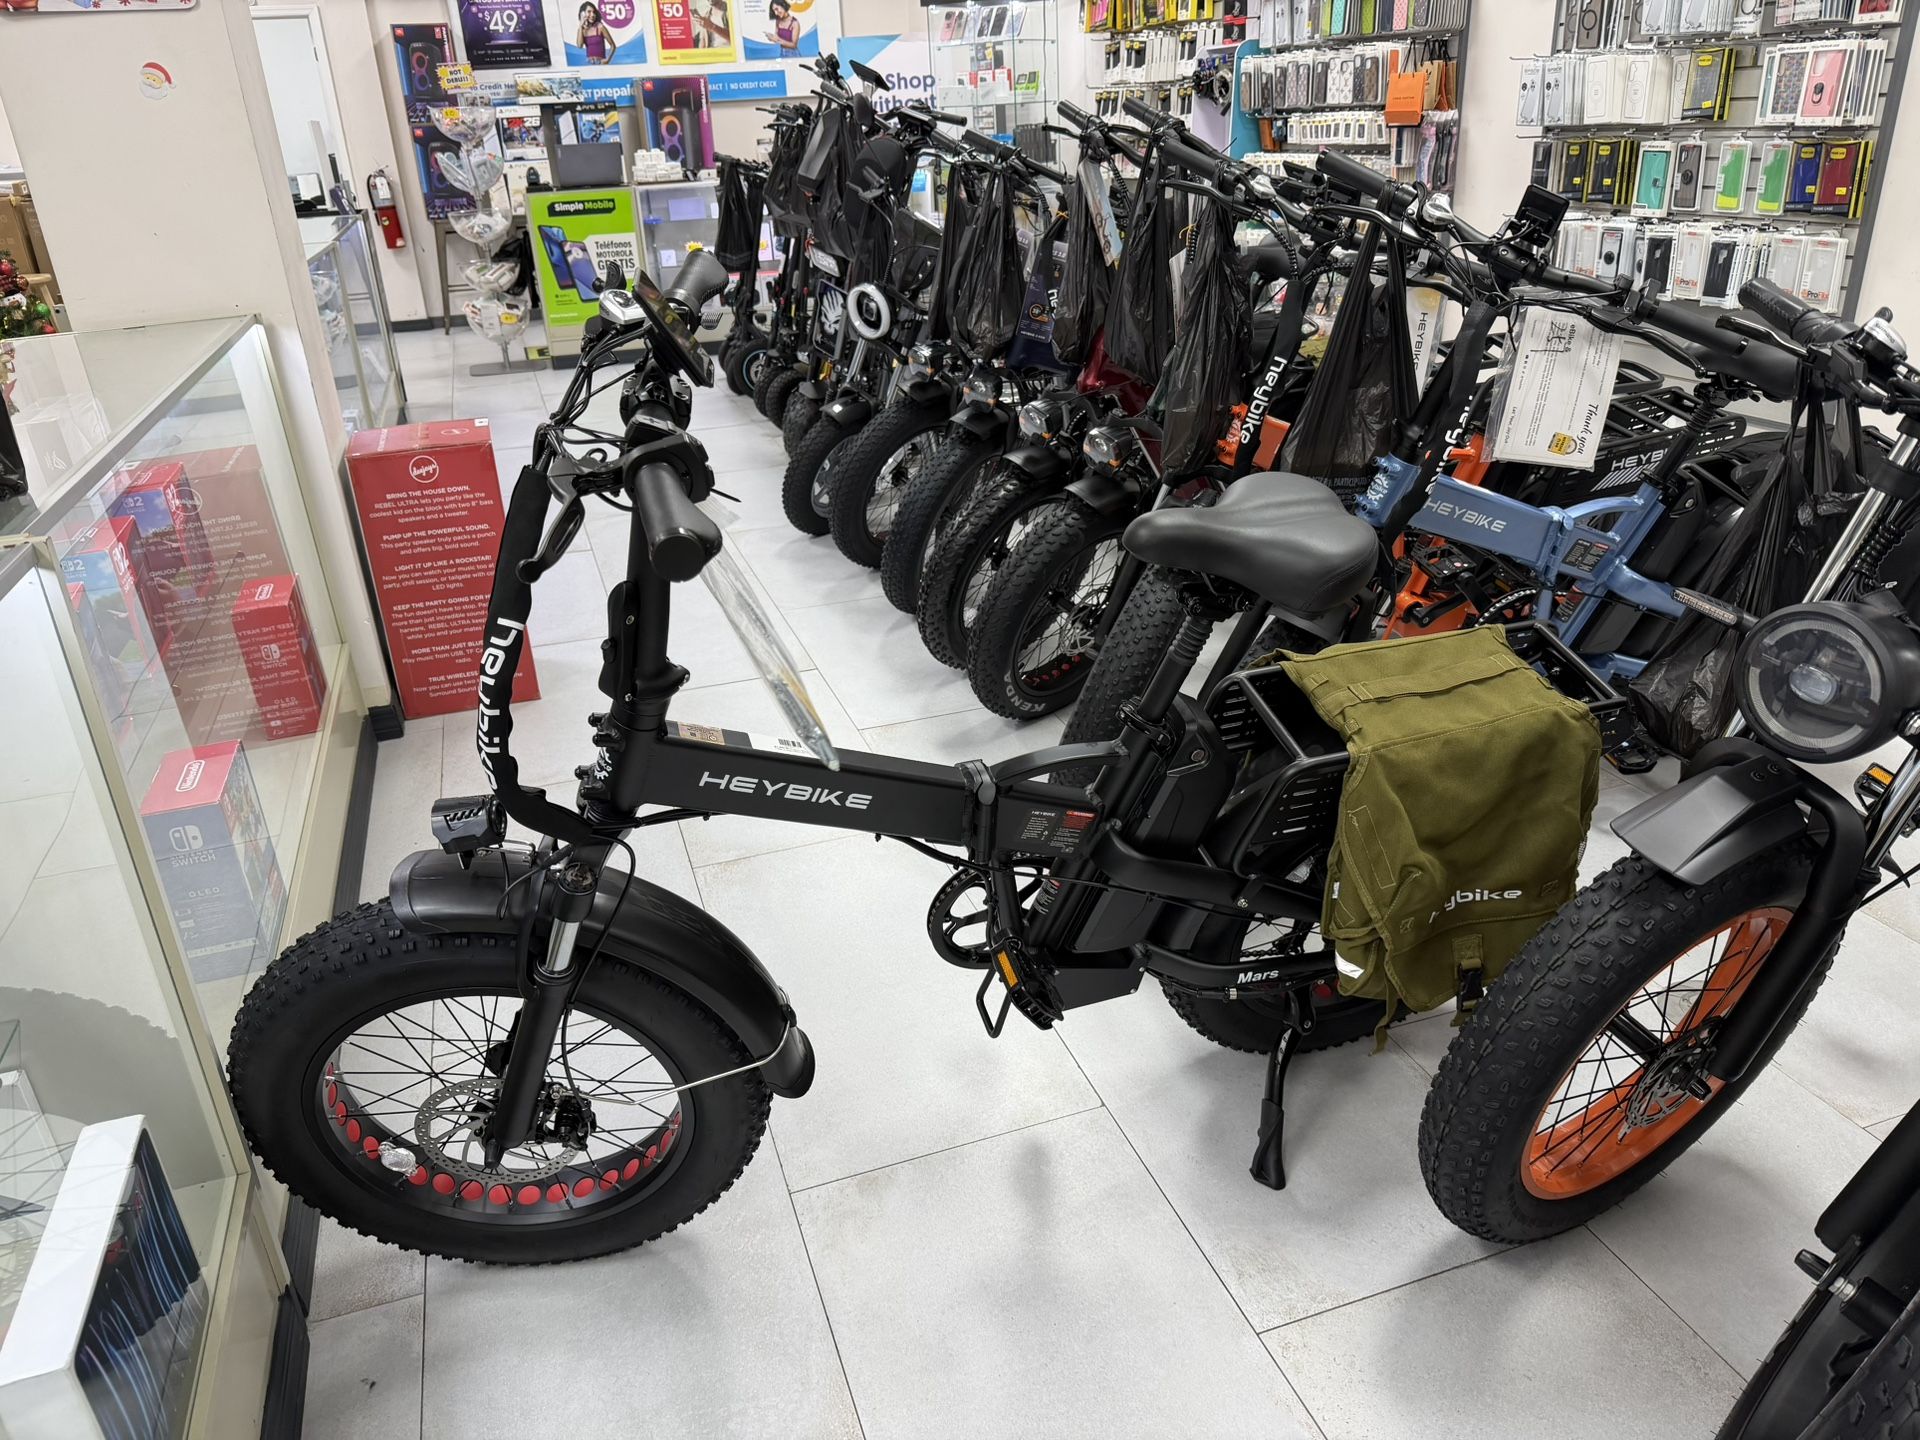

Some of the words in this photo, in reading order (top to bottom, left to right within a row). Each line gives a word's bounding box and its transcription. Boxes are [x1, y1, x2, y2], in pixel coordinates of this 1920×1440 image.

[601, 4, 625, 20] $50
[484, 9, 518, 33] $49
[480, 82, 503, 91] Credit
[739, 82, 758, 90] CREDIT
[759, 80, 777, 88] CHECK
[886, 72, 936, 92] Shop
[554, 202, 584, 212] Simple
[585, 200, 614, 210] Mobile
[594, 240, 633, 250] Teléfonos
[596, 249, 634, 259] MOTOROLA
[1565, 324, 1576, 346] eBike
[1241, 356, 1287, 445] heybike
[1579, 403, 1599, 437] Thank
[1576, 434, 1590, 455] you
[386, 491, 408, 499] BRING
[423, 487, 446, 496] HOUSE
[446, 485, 471, 493] DOWN.
[374, 501, 396, 509] REBEL
[445, 495, 462, 503] party
[425, 504, 442, 512] block
[1424, 498, 1507, 533] HEYBIKE
[427, 527, 465, 536] POWERFUL
[477, 531, 497, 539] punch
[460, 540, 480, 548] sound.
[455, 555, 492, 564] ROCKSTAR!
[448, 573, 472, 581] tailgate
[425, 599, 447, 607] PARTY
[415, 608, 438, 616] doesn't
[435, 613, 466, 621] incredible
[446, 670, 479, 680] WIRELESS
[429, 689, 457, 697] Surround
[1004, 670, 1046, 712] KENDA
[699, 771, 873, 810] HEYBIKE
[172, 853, 216, 868] SWITCH
[1237, 968, 1280, 985] Mars
